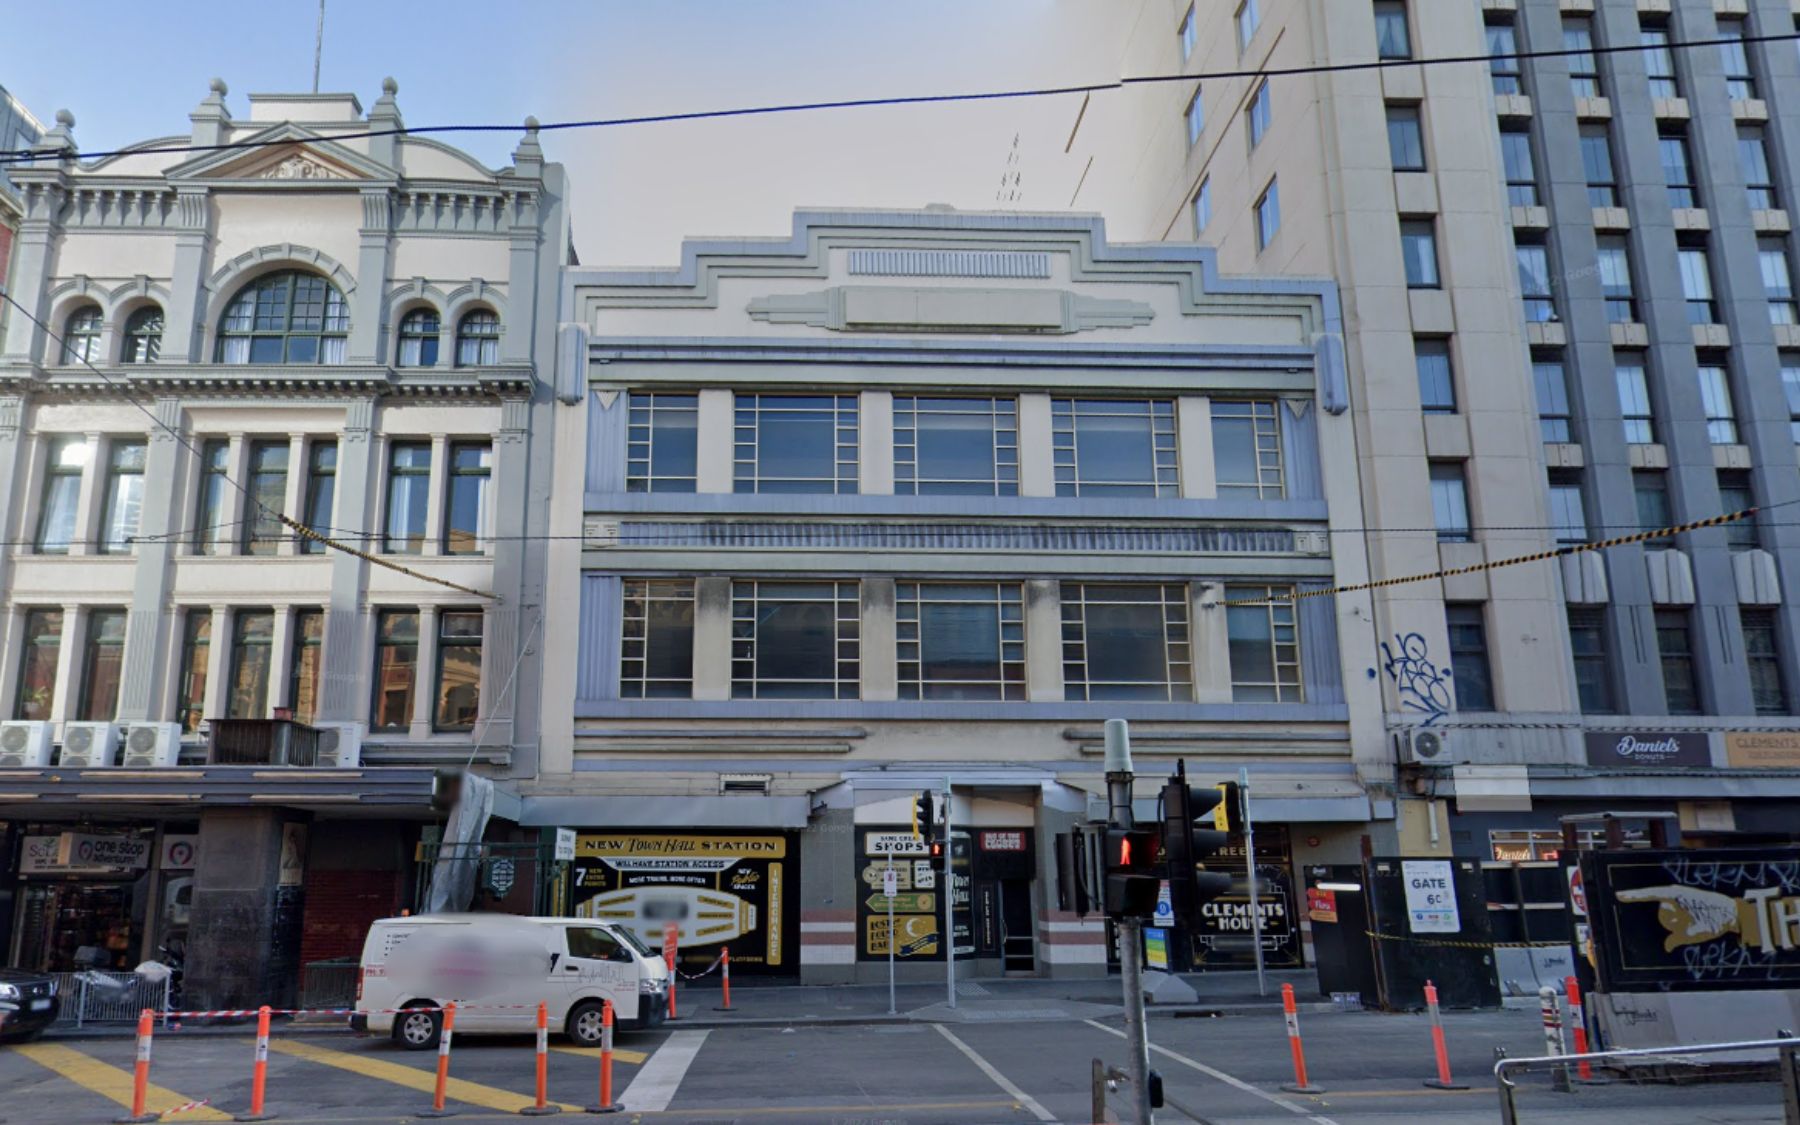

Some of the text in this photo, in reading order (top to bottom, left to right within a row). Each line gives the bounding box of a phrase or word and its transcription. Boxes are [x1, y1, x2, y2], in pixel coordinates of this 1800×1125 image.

[119, 840, 144, 855] stop
[585, 840, 624, 850] NEW
[701, 841, 777, 851] STATION
[875, 842, 924, 851] SHOPS
[654, 860, 689, 868] STATION
[692, 860, 725, 868] ACCESS
[575, 868, 587, 886] 7
[1411, 878, 1447, 889] GATE
